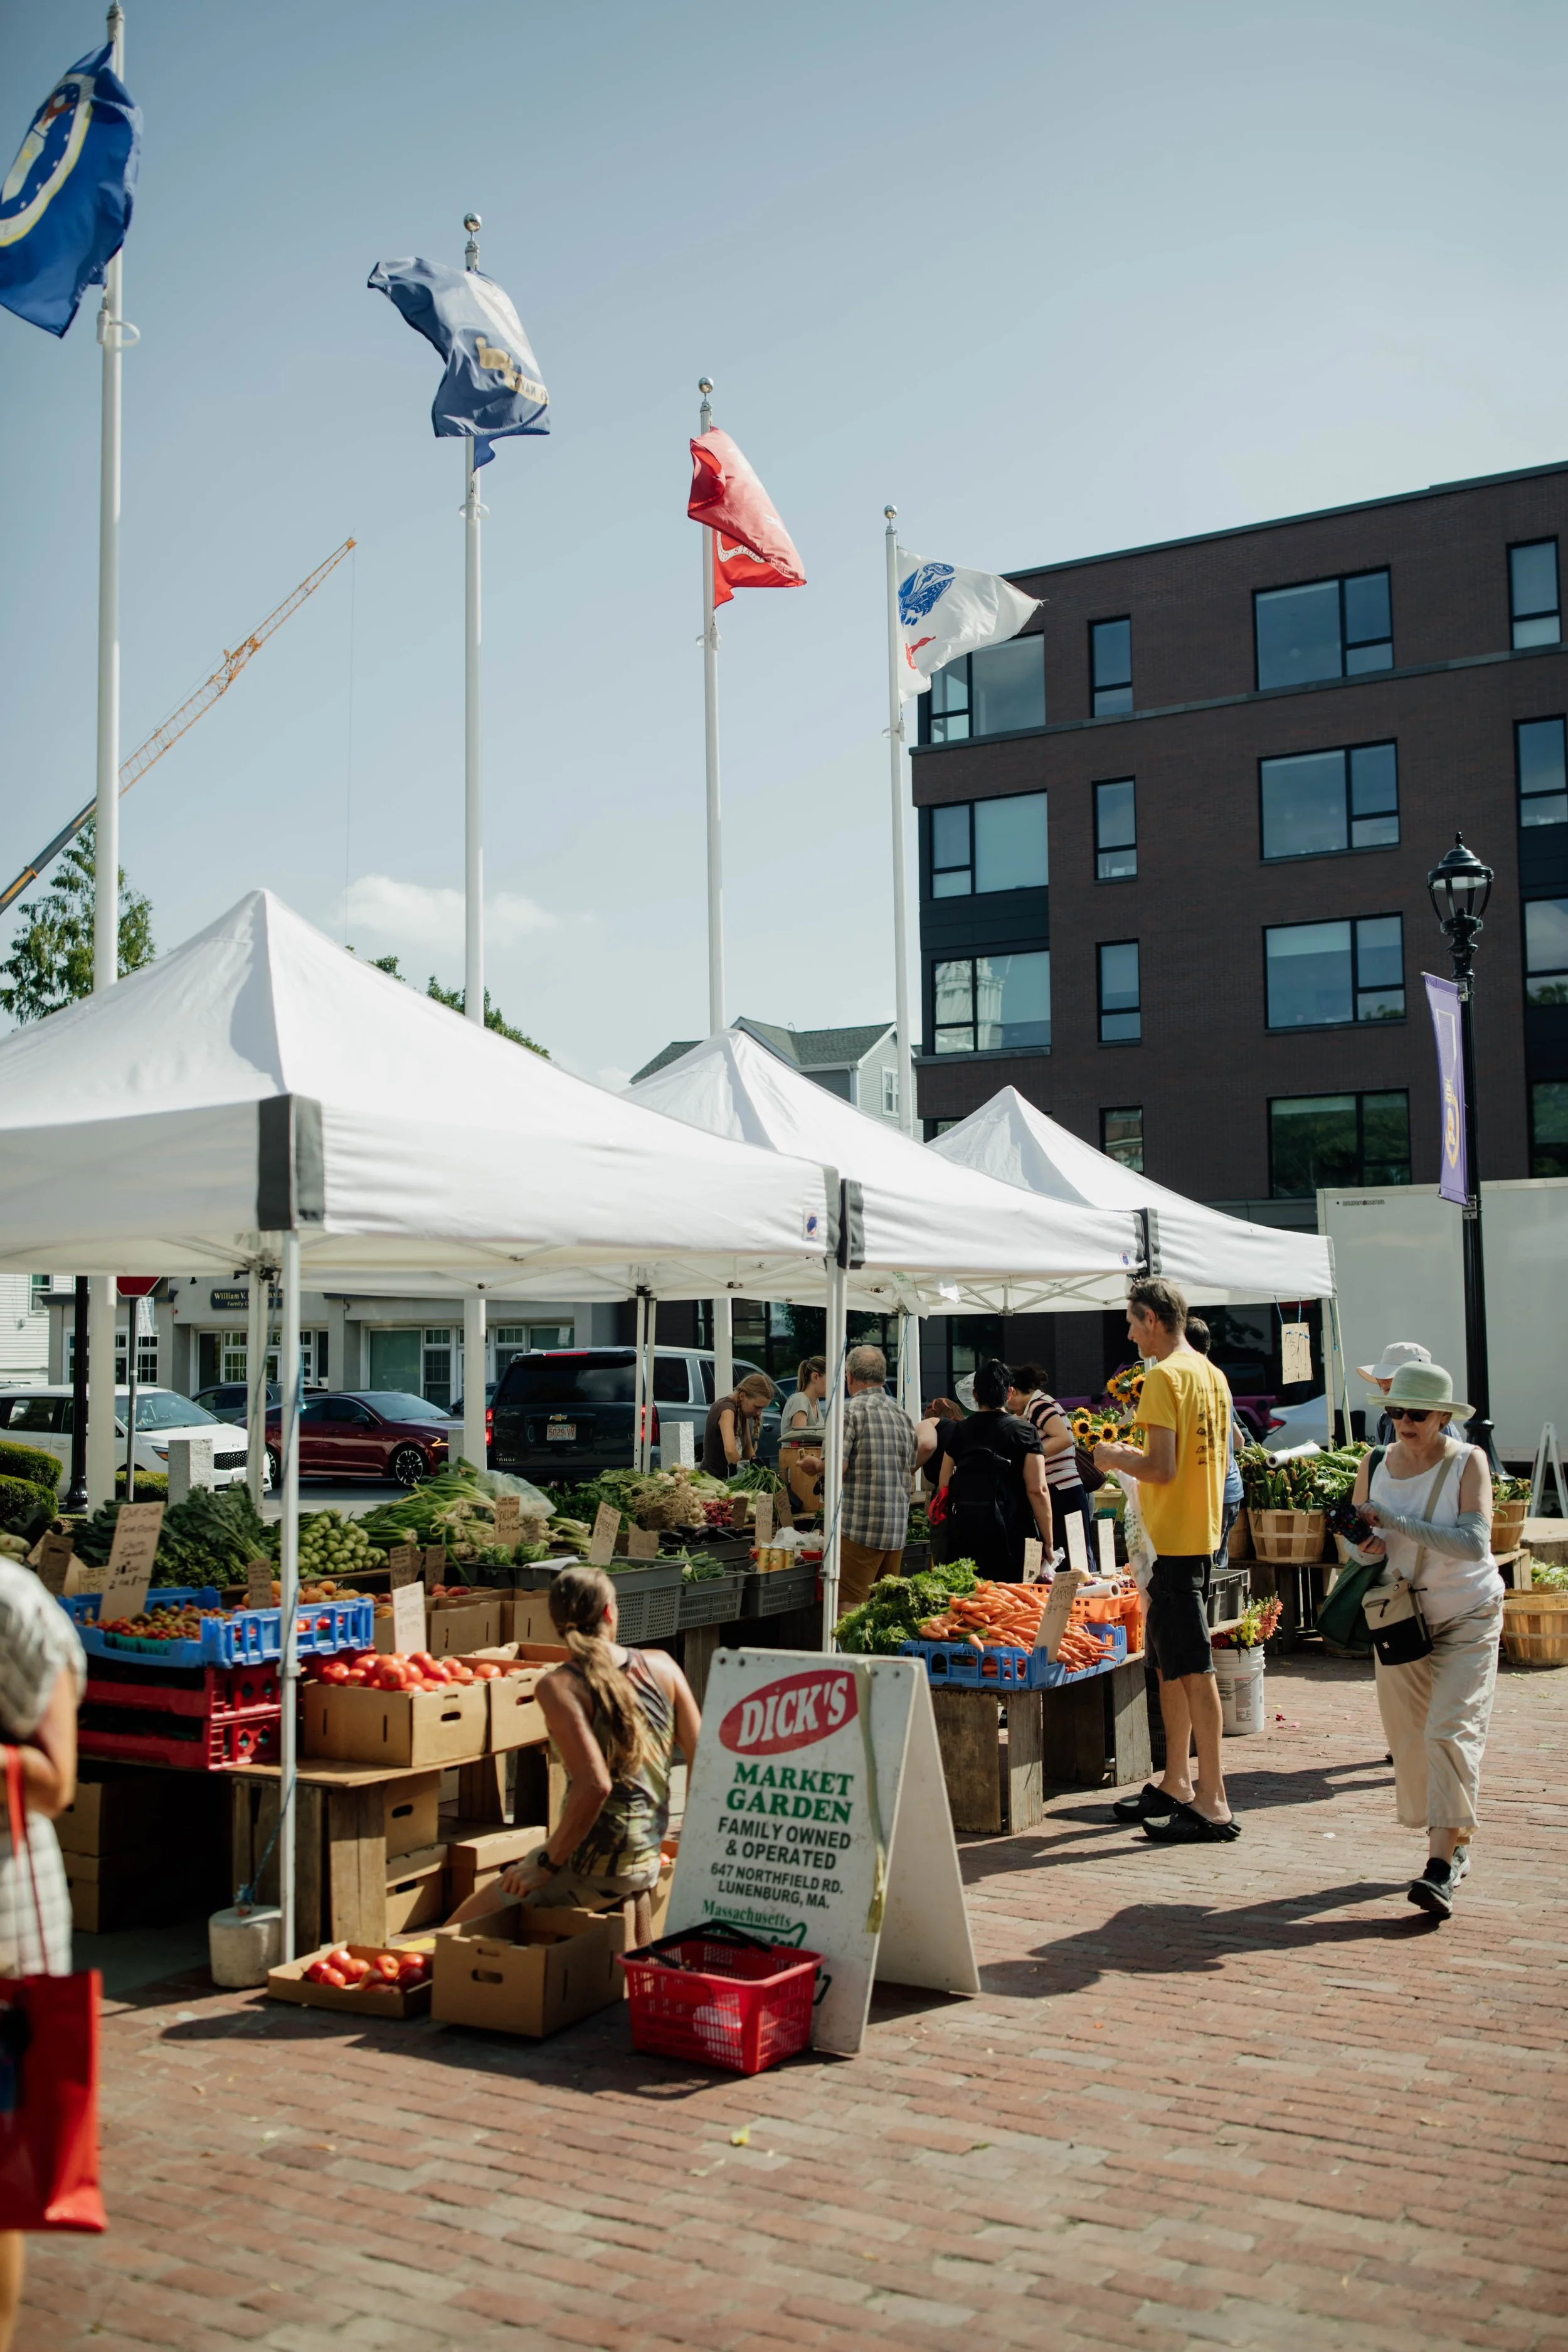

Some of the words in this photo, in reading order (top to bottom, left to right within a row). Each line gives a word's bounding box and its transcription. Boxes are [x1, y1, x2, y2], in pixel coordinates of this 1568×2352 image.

[736, 1676, 848, 1747] DICK'S
[733, 1762, 854, 1796] MARKET
[726, 1788, 853, 1825] GARDEN
[718, 1816, 783, 1841] FAMILY
[786, 1826, 851, 1850] OWNED
[726, 1839, 737, 1855] &
[742, 1841, 836, 1870] OPERATED
[711, 1862, 734, 1875] 647
[736, 1865, 820, 1890] NORTHFIELD
[822, 1878, 844, 1894] RD.
[718, 1880, 803, 1908] LUNENBURG,
[806, 1893, 830, 1909] MA.
[701, 1899, 792, 1928] Massachusetts
